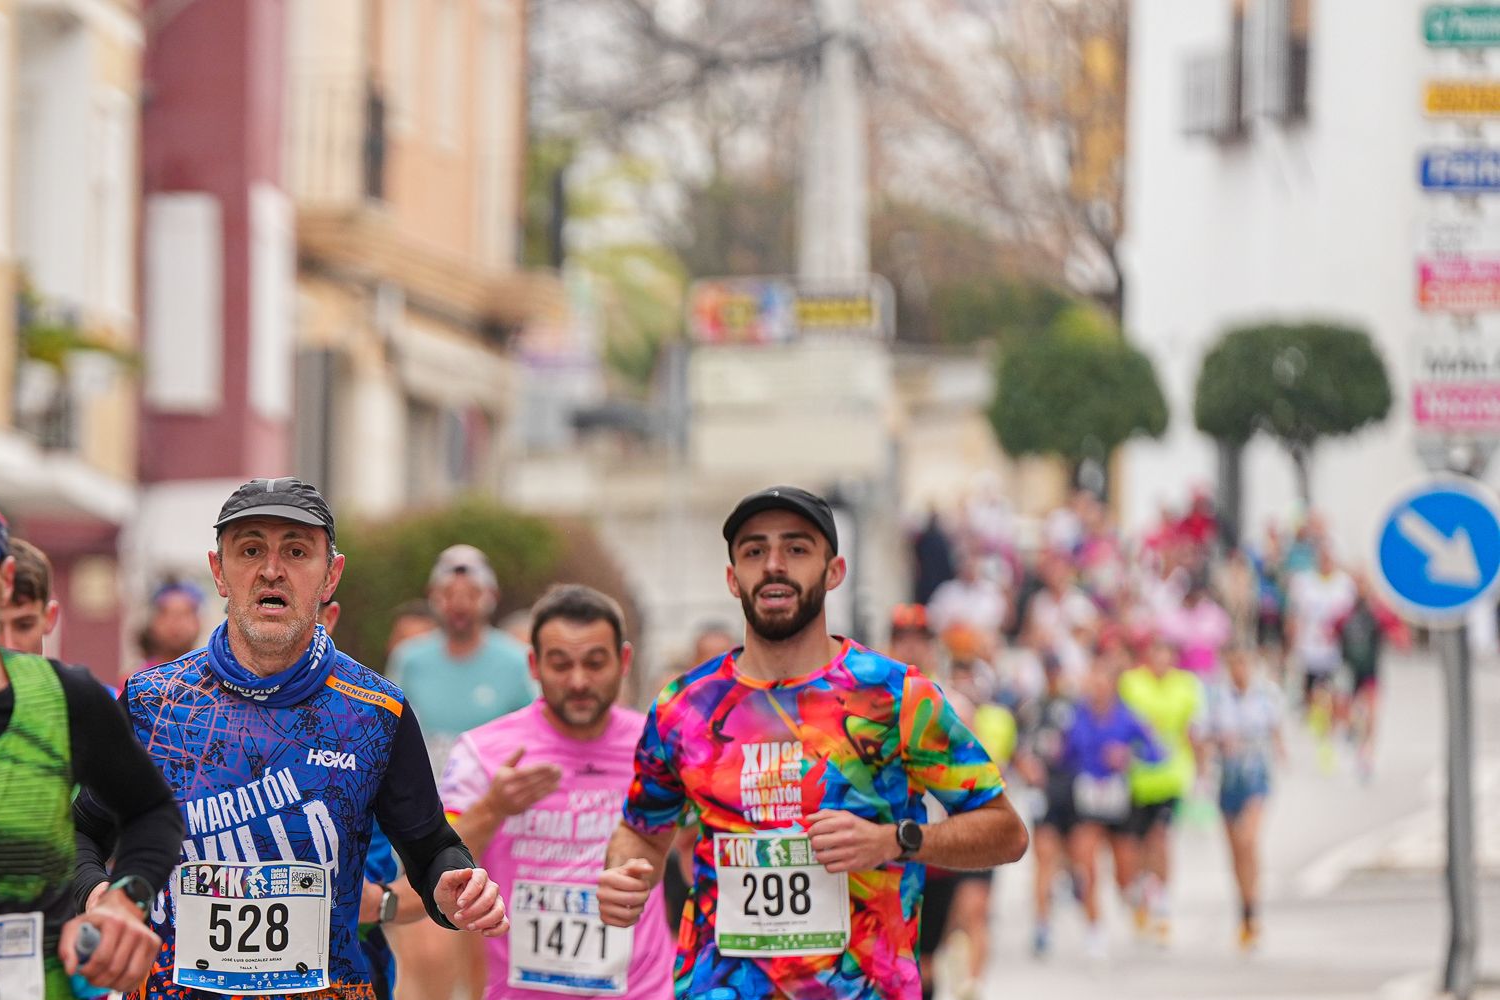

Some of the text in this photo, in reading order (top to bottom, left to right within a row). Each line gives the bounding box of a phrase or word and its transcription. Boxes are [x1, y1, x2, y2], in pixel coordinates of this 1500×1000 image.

[306, 748, 357, 771] HOKA
[740, 771, 782, 790] MEDIA
[741, 783, 803, 809] MARATÓN
[186, 766, 302, 836] MARATÓN
[725, 838, 759, 867] 10K
[198, 865, 246, 898] 21K
[743, 872, 811, 917] 298
[209, 903, 289, 952] 528
[528, 917, 607, 959] 1471
